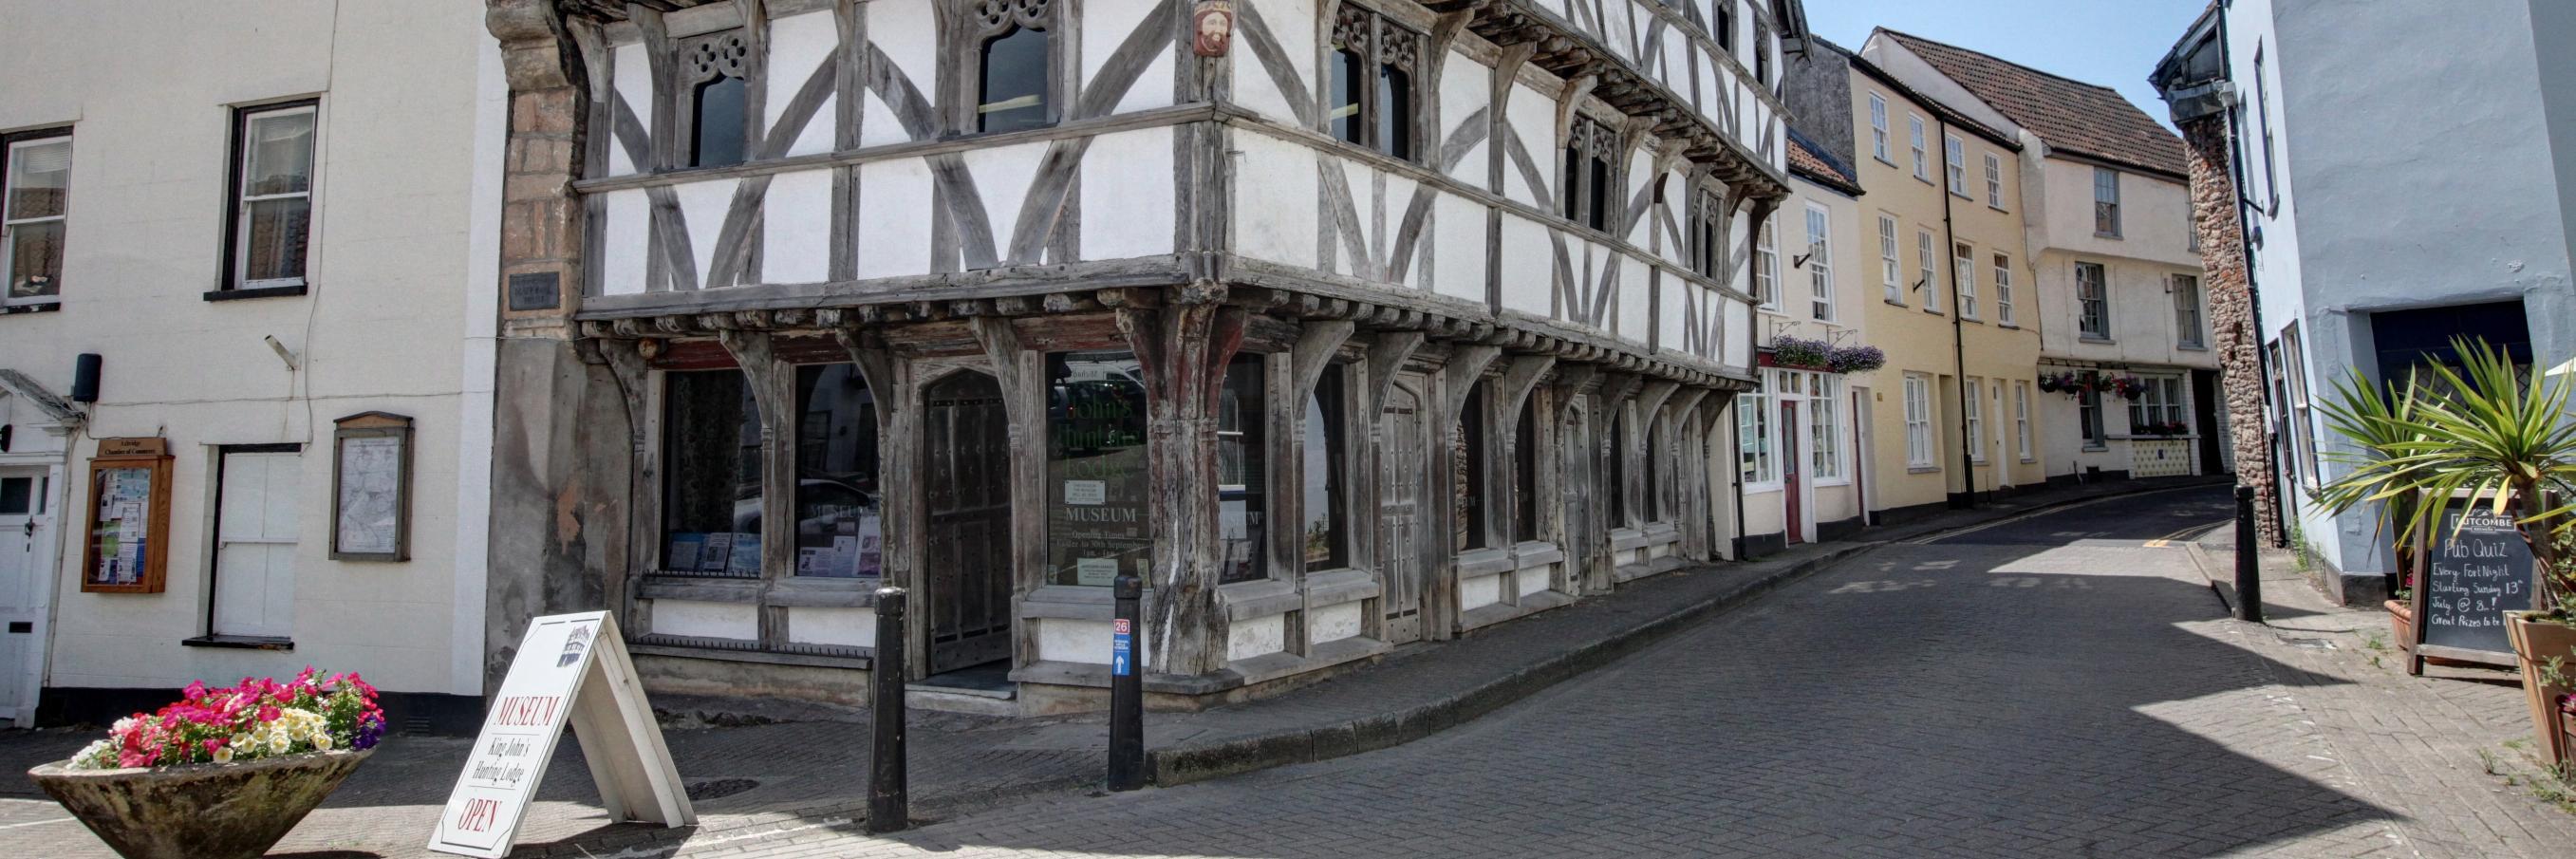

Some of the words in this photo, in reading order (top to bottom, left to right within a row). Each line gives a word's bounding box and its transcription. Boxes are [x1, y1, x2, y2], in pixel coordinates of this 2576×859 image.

[1065, 506, 1137, 522] MUSEUM
[2444, 538, 2470, 558] Pub
[2473, 538, 2509, 558] Quiz
[2433, 562, 2460, 582] Every
[2432, 580, 2470, 596] Starting
[2473, 582, 2502, 597] Sunday
[1115, 622, 1128, 632] 26
[2431, 613, 2455, 626] Great
[2458, 615, 2482, 627] Prizes
[2483, 616, 2491, 626] to
[494, 696, 560, 727] MUSEUM
[487, 737, 508, 761] King
[504, 738, 532, 757] John's
[472, 760, 503, 786] Hunting
[499, 761, 525, 788] Lodge
[457, 797, 503, 833] OPEN
